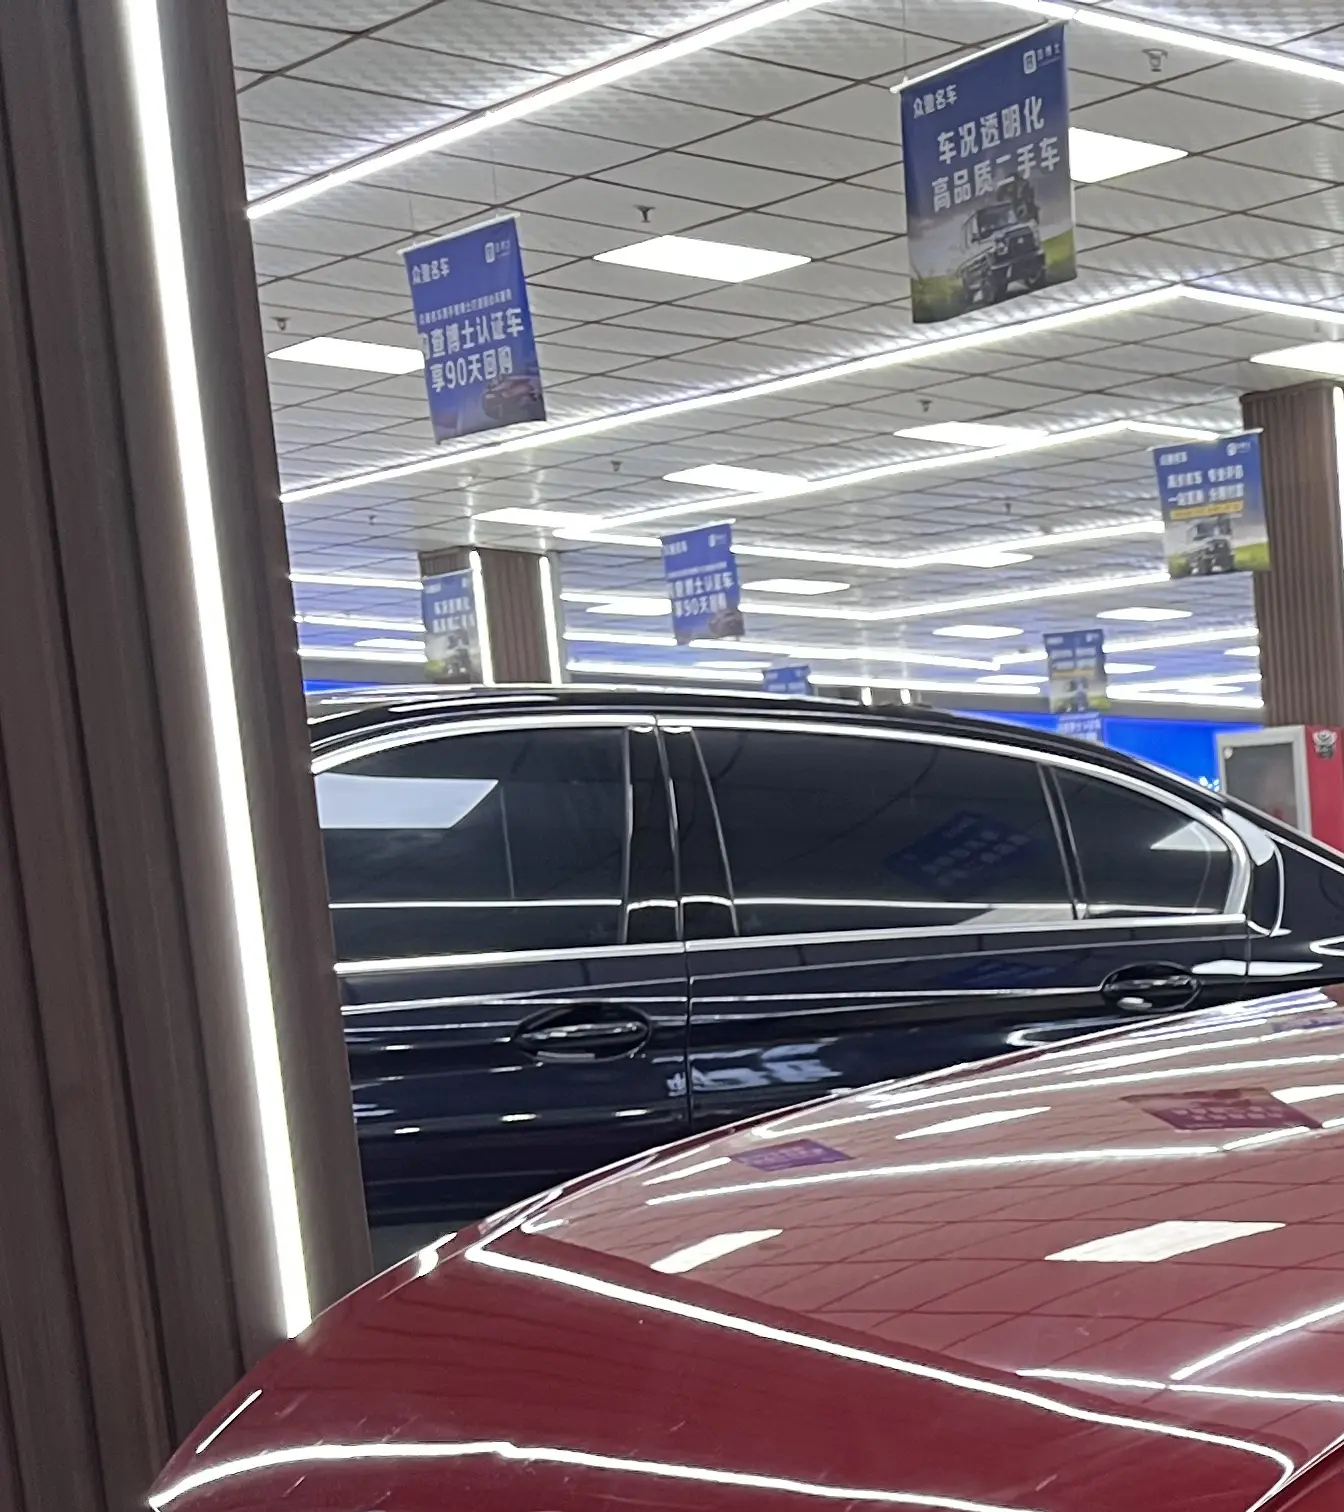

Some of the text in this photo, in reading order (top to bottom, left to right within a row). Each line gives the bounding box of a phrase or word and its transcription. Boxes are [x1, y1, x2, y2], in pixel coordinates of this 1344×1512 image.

[937, 96, 1045, 165] 车况透明化
[932, 136, 1060, 213] 高品质二手车
